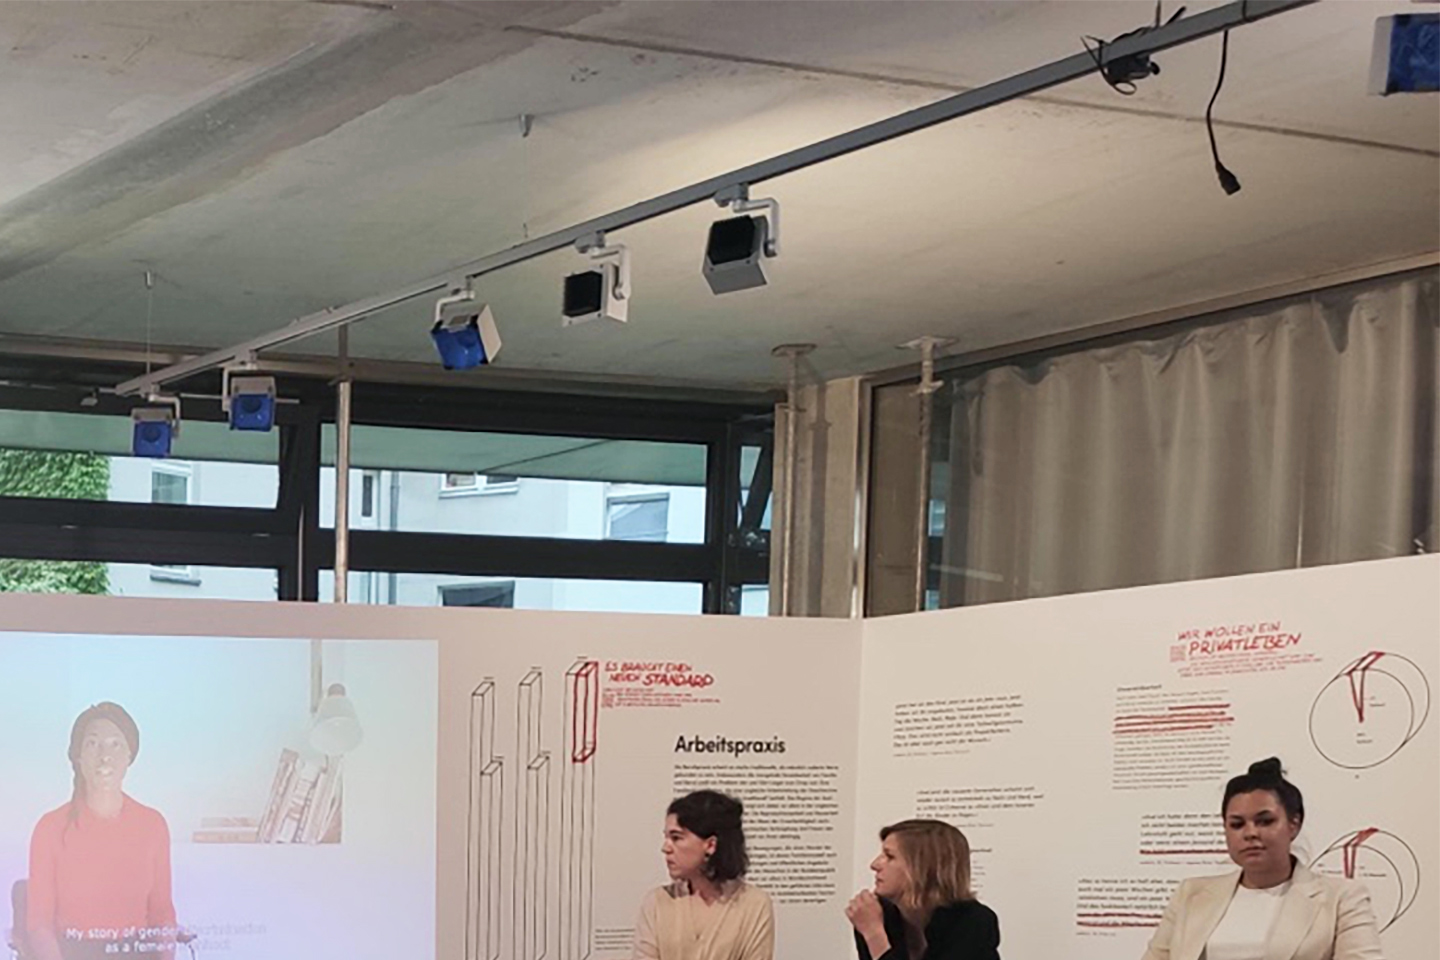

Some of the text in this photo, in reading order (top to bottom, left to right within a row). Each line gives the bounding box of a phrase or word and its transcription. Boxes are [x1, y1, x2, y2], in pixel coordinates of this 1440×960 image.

[1258, 621, 1281, 634] EIN
[1188, 632, 1302, 656] PRIVATLEBEN
[642, 673, 714, 688] STANDARD
[674, 735, 786, 758] Arbeitspraxis
[66, 928, 84, 941] My
[88, 928, 118, 940] story
[122, 926, 135, 937] of
[105, 943, 118, 953] as
